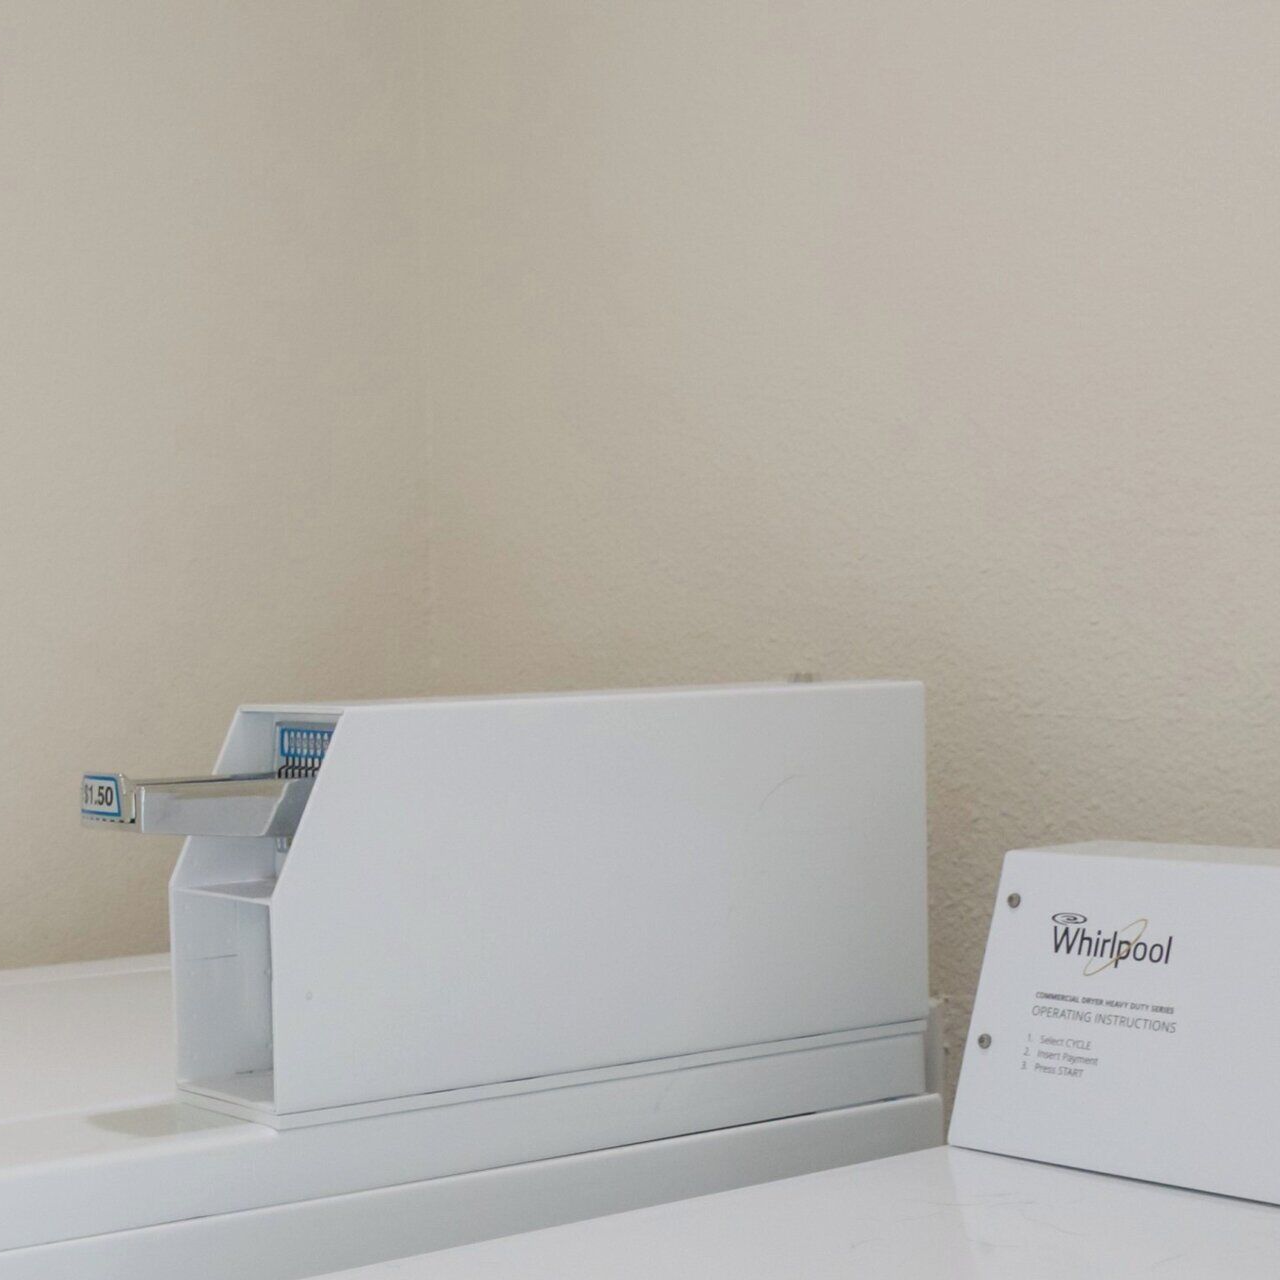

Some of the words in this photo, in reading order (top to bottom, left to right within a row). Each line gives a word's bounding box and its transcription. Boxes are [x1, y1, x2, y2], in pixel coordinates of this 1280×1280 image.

[84, 783, 114, 807] $1.50
[1053, 924, 1173, 969] Whirlpool
[1035, 991, 1080, 1004] COMMERCIAL
[1081, 996, 1104, 1006] DRYER
[1105, 999, 1129, 1009] HEAVY
[1129, 1002, 1150, 1011] DUTY
[1150, 1005, 1175, 1015] SERIES
[1031, 1004, 1092, 1023] OPERATING
[1094, 1012, 1177, 1034] INSTRUCTIONS
[1039, 1034, 1065, 1048] Select
[1065, 1038, 1092, 1051] CYCLE
[1034, 1062, 1057, 1075] Press
[1057, 1065, 1084, 1078] START
[1037, 1049, 1061, 1061] Insert
[1062, 1052, 1099, 1067] Payment
